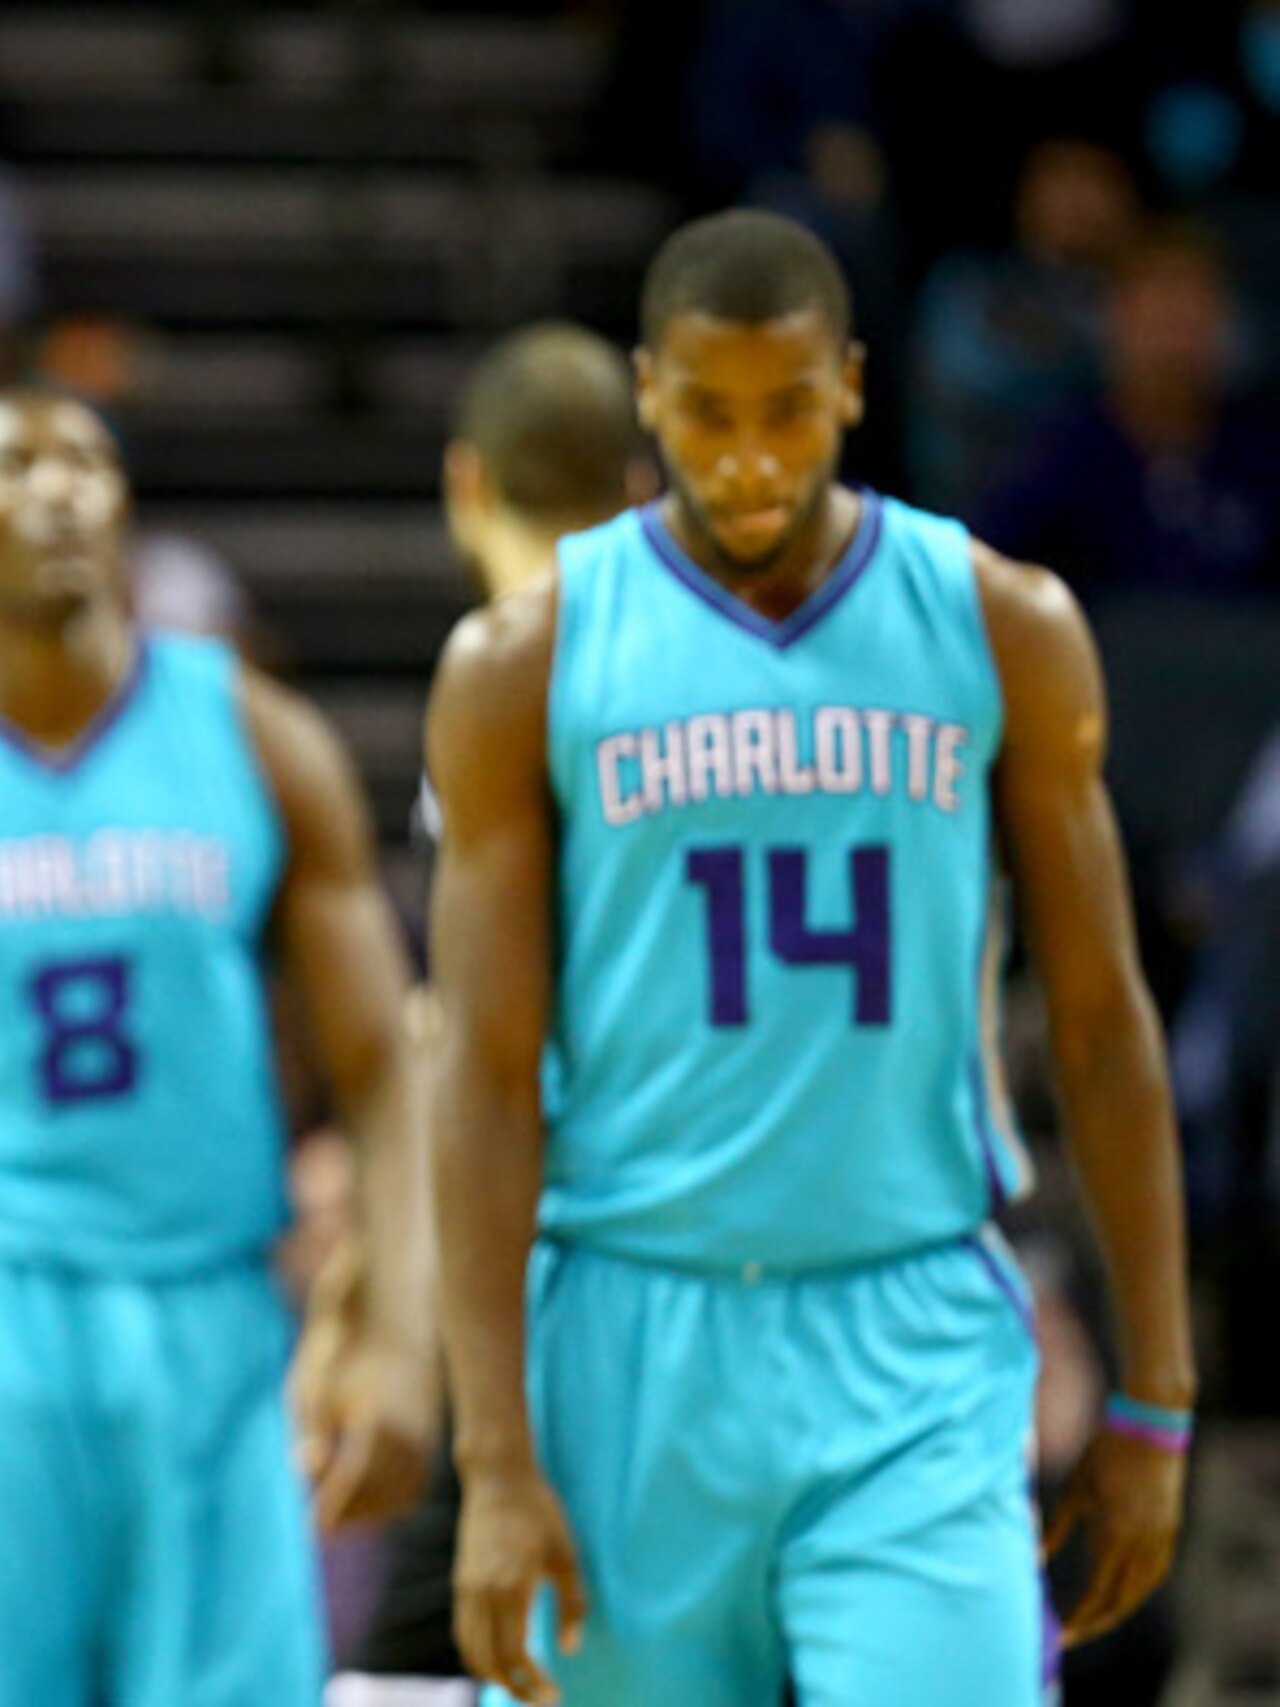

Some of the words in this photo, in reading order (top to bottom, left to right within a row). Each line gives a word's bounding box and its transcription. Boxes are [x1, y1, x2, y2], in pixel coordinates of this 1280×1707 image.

[596, 706, 968, 827] CHARLOTTE
[686, 843, 892, 1029] 14
[32, 956, 138, 1107] 8
